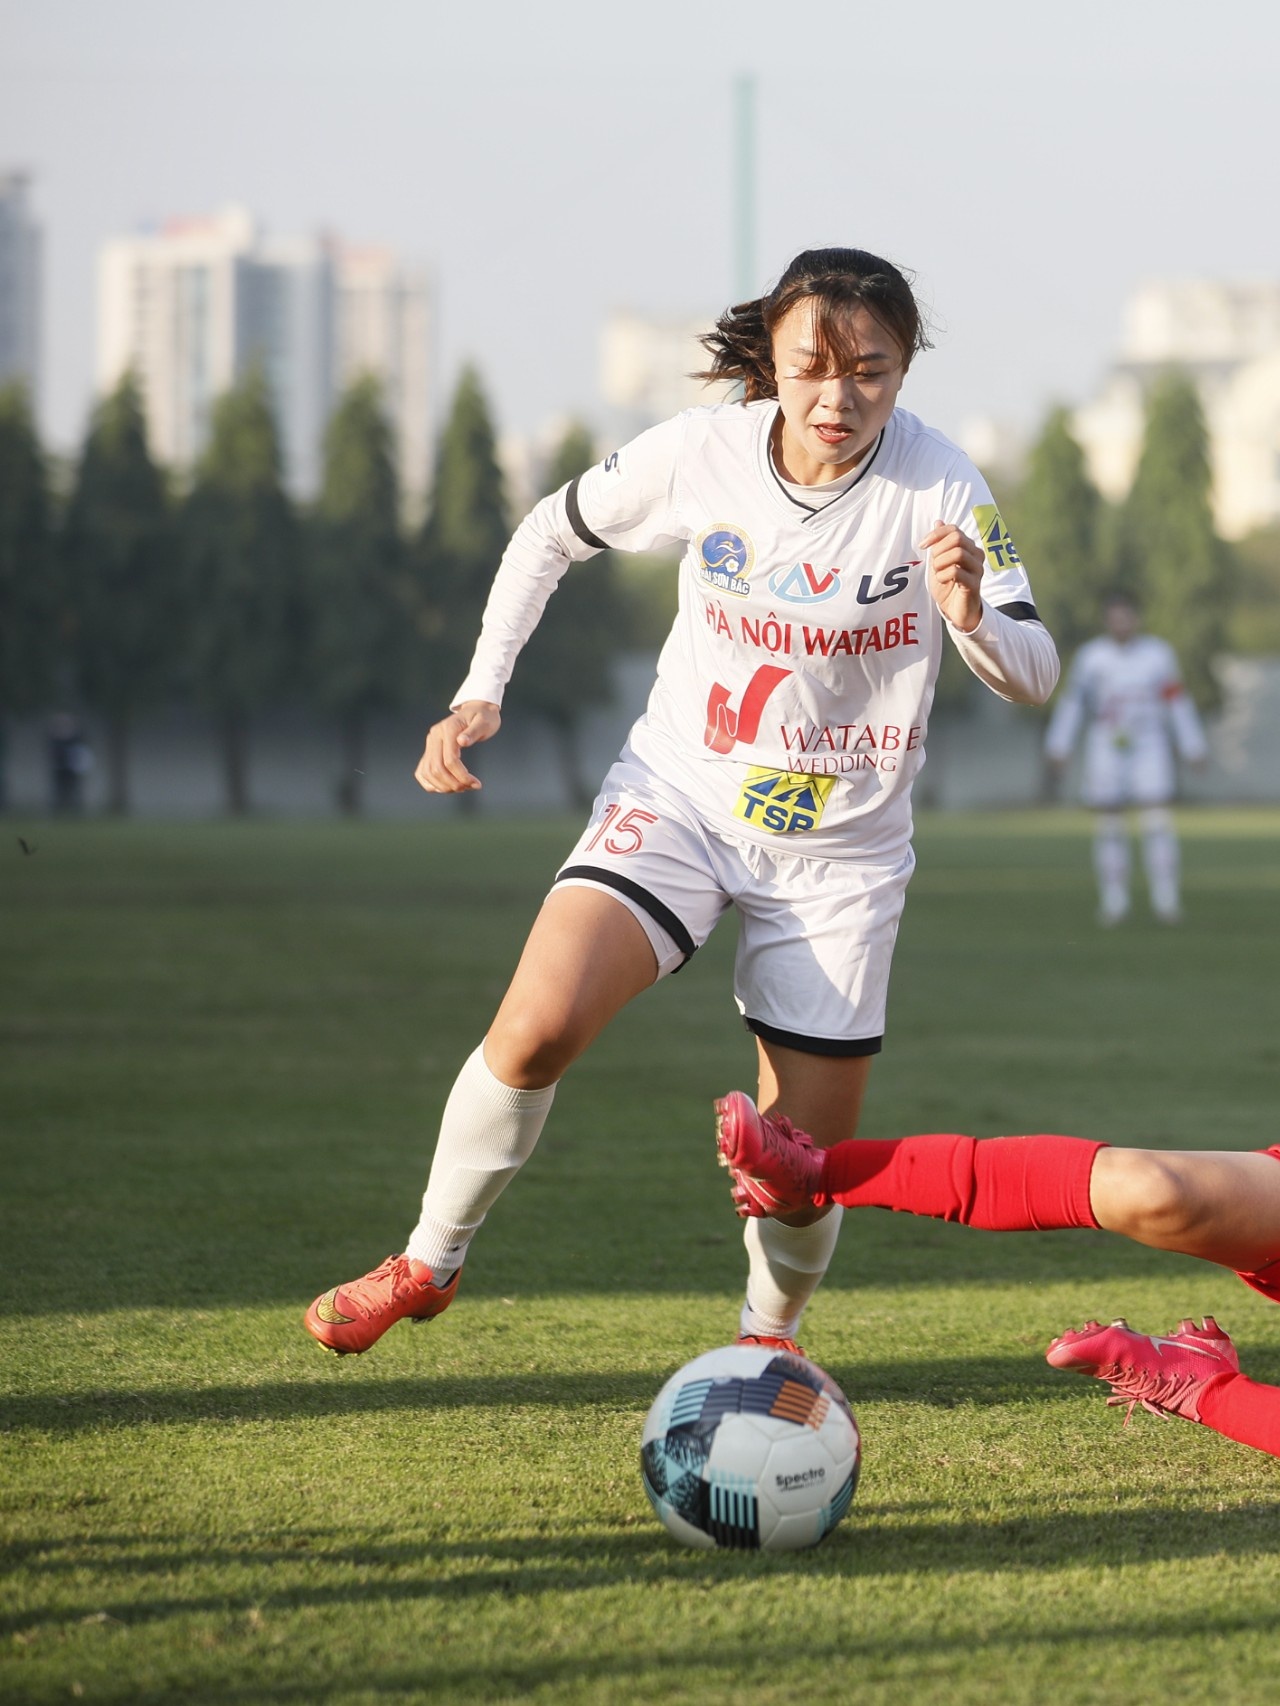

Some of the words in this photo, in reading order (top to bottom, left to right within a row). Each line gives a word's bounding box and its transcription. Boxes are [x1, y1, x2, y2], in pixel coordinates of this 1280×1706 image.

[856, 564, 910, 605] LS
[705, 600, 733, 641] HÀ
[741, 611, 792, 658] NỘI
[803, 612, 919, 657] WATABE
[780, 724, 922, 752] WATABE
[787, 753, 898, 774] WEDDING
[584, 803, 659, 855] 15
